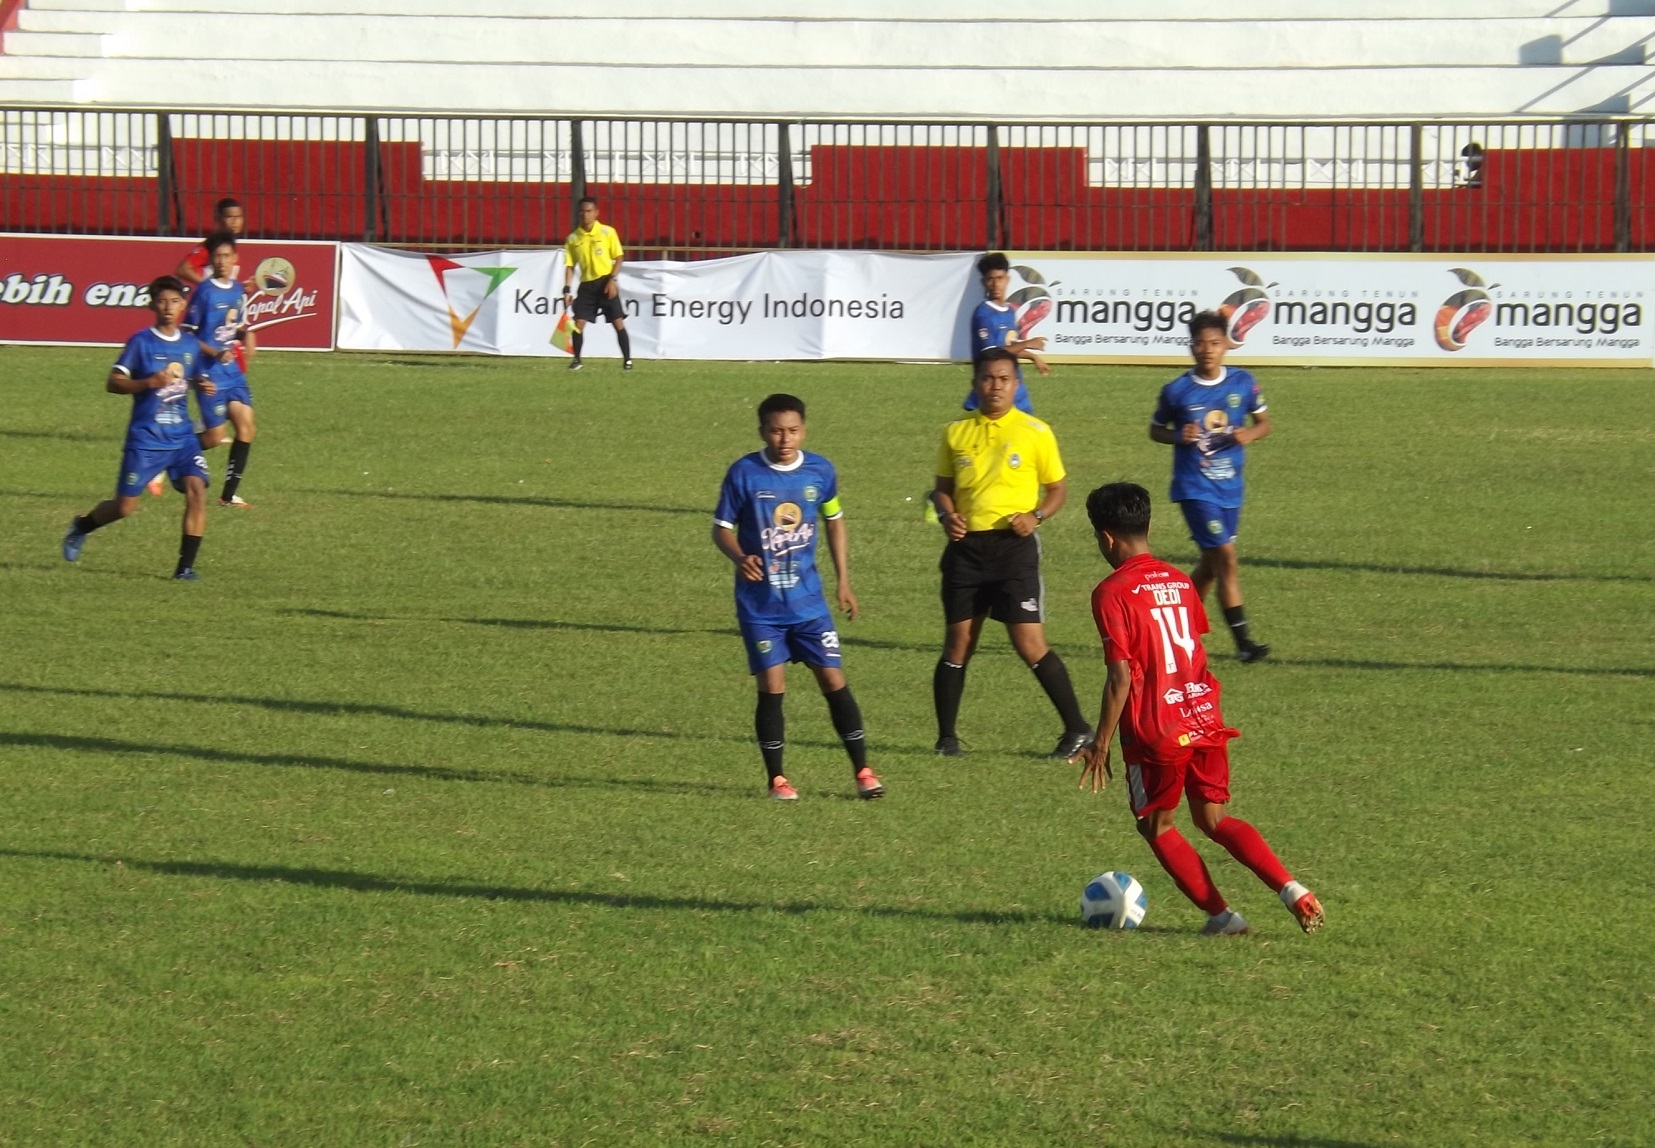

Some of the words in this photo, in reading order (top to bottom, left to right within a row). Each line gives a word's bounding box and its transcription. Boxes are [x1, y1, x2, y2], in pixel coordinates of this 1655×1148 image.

[0, 274, 73, 305] bih
[84, 282, 152, 307] ena
[1056, 288, 1131, 297] SARUNG
[1142, 288, 1198, 297] TENUN
[1274, 290, 1350, 298] SARUNG
[1361, 290, 1419, 298] TENUN
[1496, 290, 1573, 299] SARUNG
[1585, 290, 1643, 299] TENUN
[240, 290, 284, 325] Kapal
[280, 287, 319, 314] Api
[514, 288, 640, 318] Kann
[651, 292, 752, 326] Energy
[763, 292, 905, 319] Indonesia
[1055, 300, 1196, 332] mangga
[1273, 301, 1417, 333] mangga
[1495, 302, 1642, 334] mangga
[1054, 333, 1093, 346] Bangga
[1095, 334, 1150, 346] Bersarung
[1272, 335, 1311, 347] Bangga
[1313, 335, 1369, 348] Bersarung
[1371, 336, 1416, 348] Mangga
[1494, 336, 1534, 348] Bangga
[1536, 336, 1592, 349] Bersarung
[1595, 337, 1641, 349] Mangga
[1152, 588, 1182, 606] DEDI
[1150, 606, 1196, 675] 14
